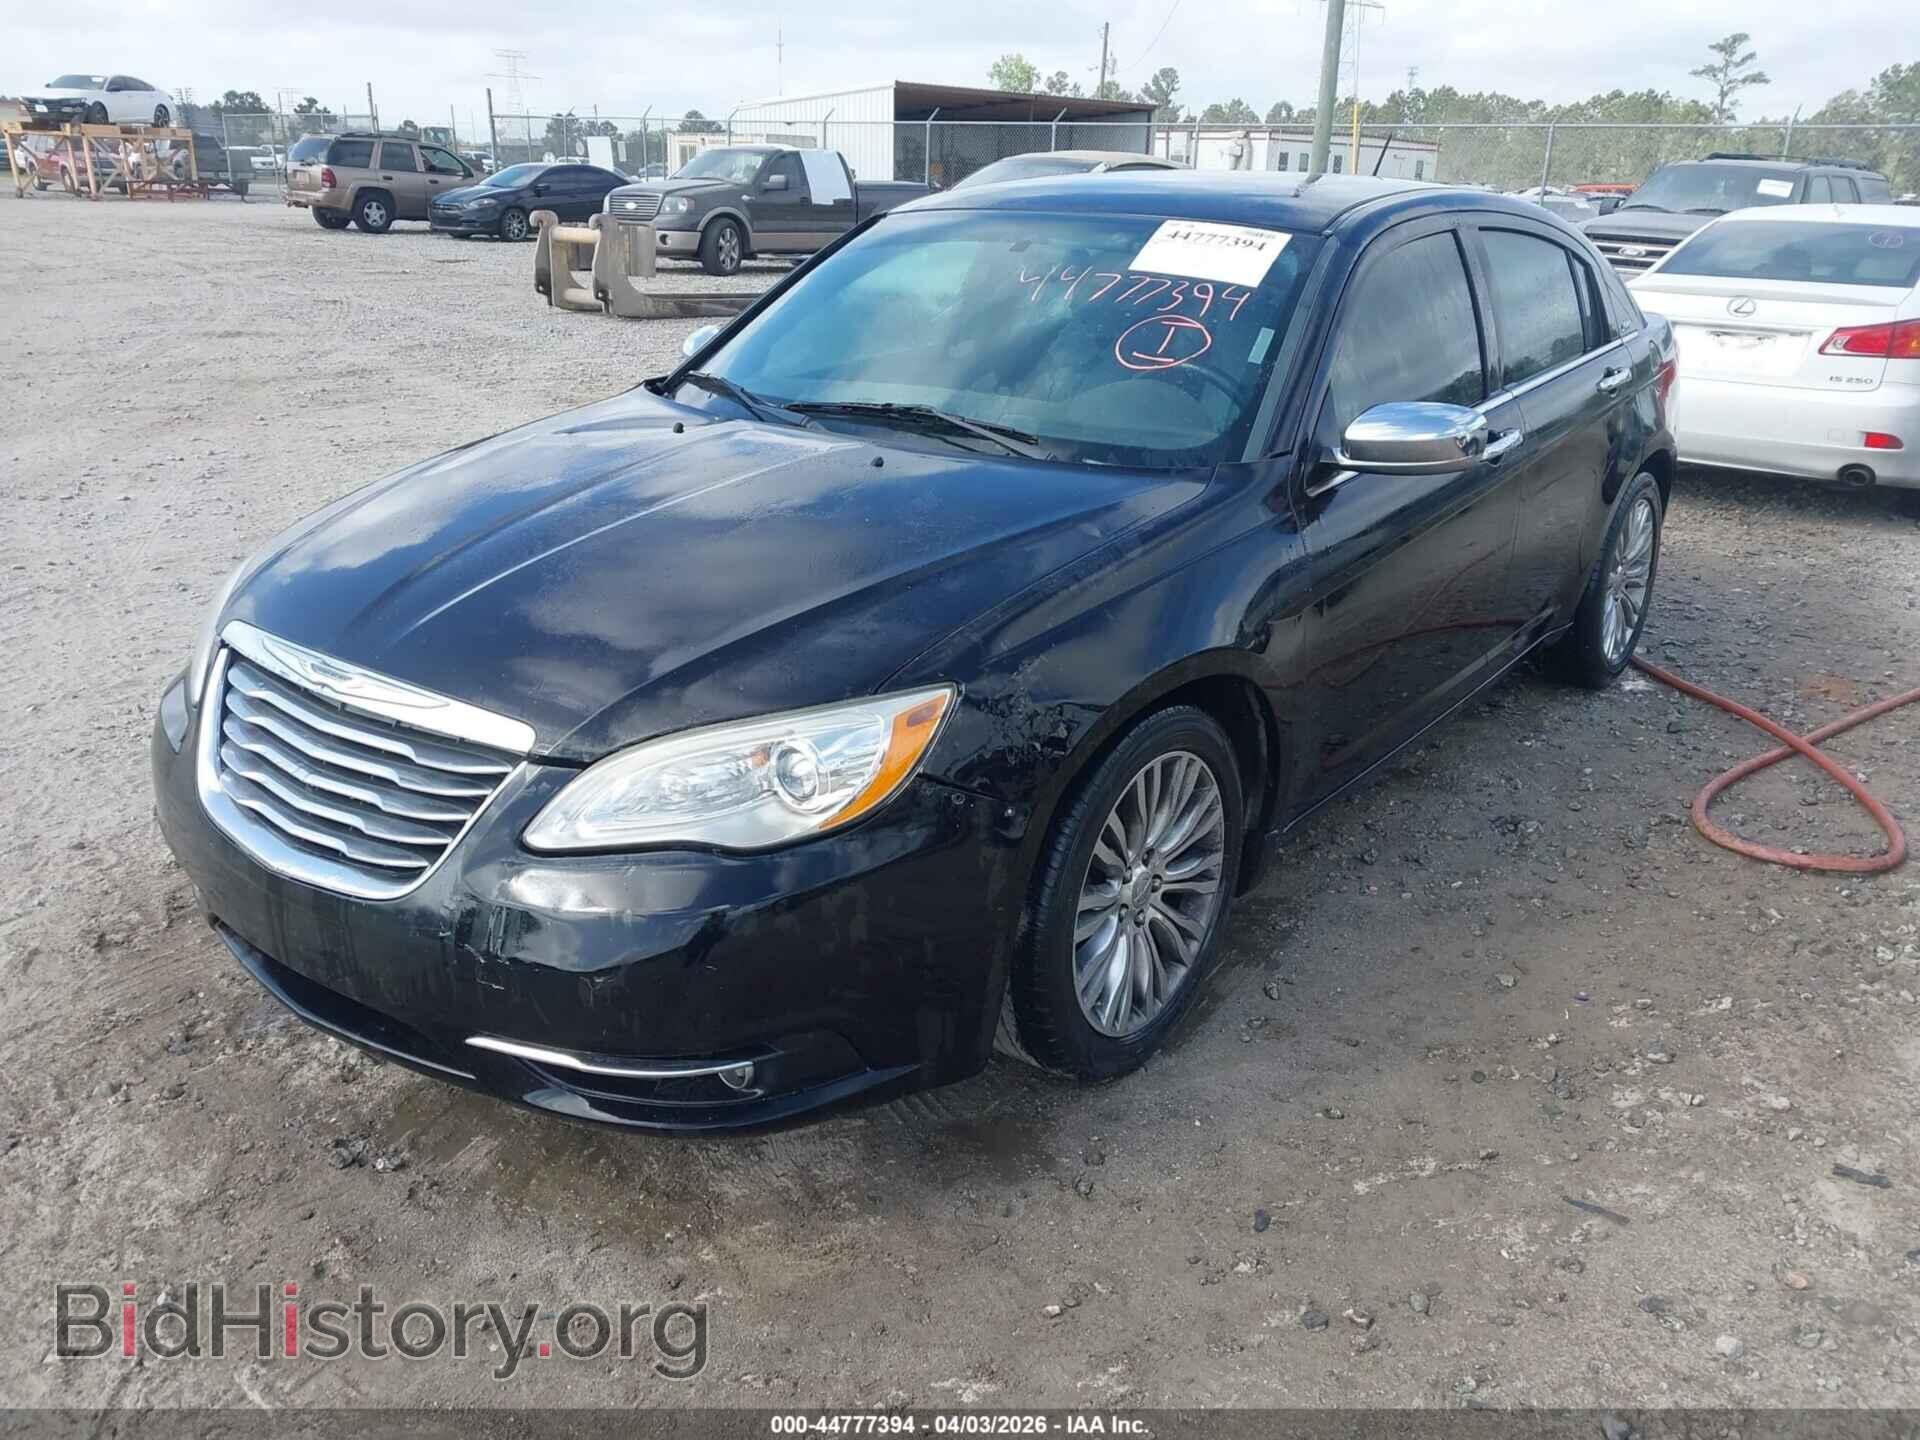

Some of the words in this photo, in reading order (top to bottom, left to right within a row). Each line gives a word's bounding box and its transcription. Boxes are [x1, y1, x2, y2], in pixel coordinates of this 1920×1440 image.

[1166, 230, 1267, 251] 44777394
[1019, 264, 1251, 321] 44777394
[1845, 376, 1873, 385] 250
